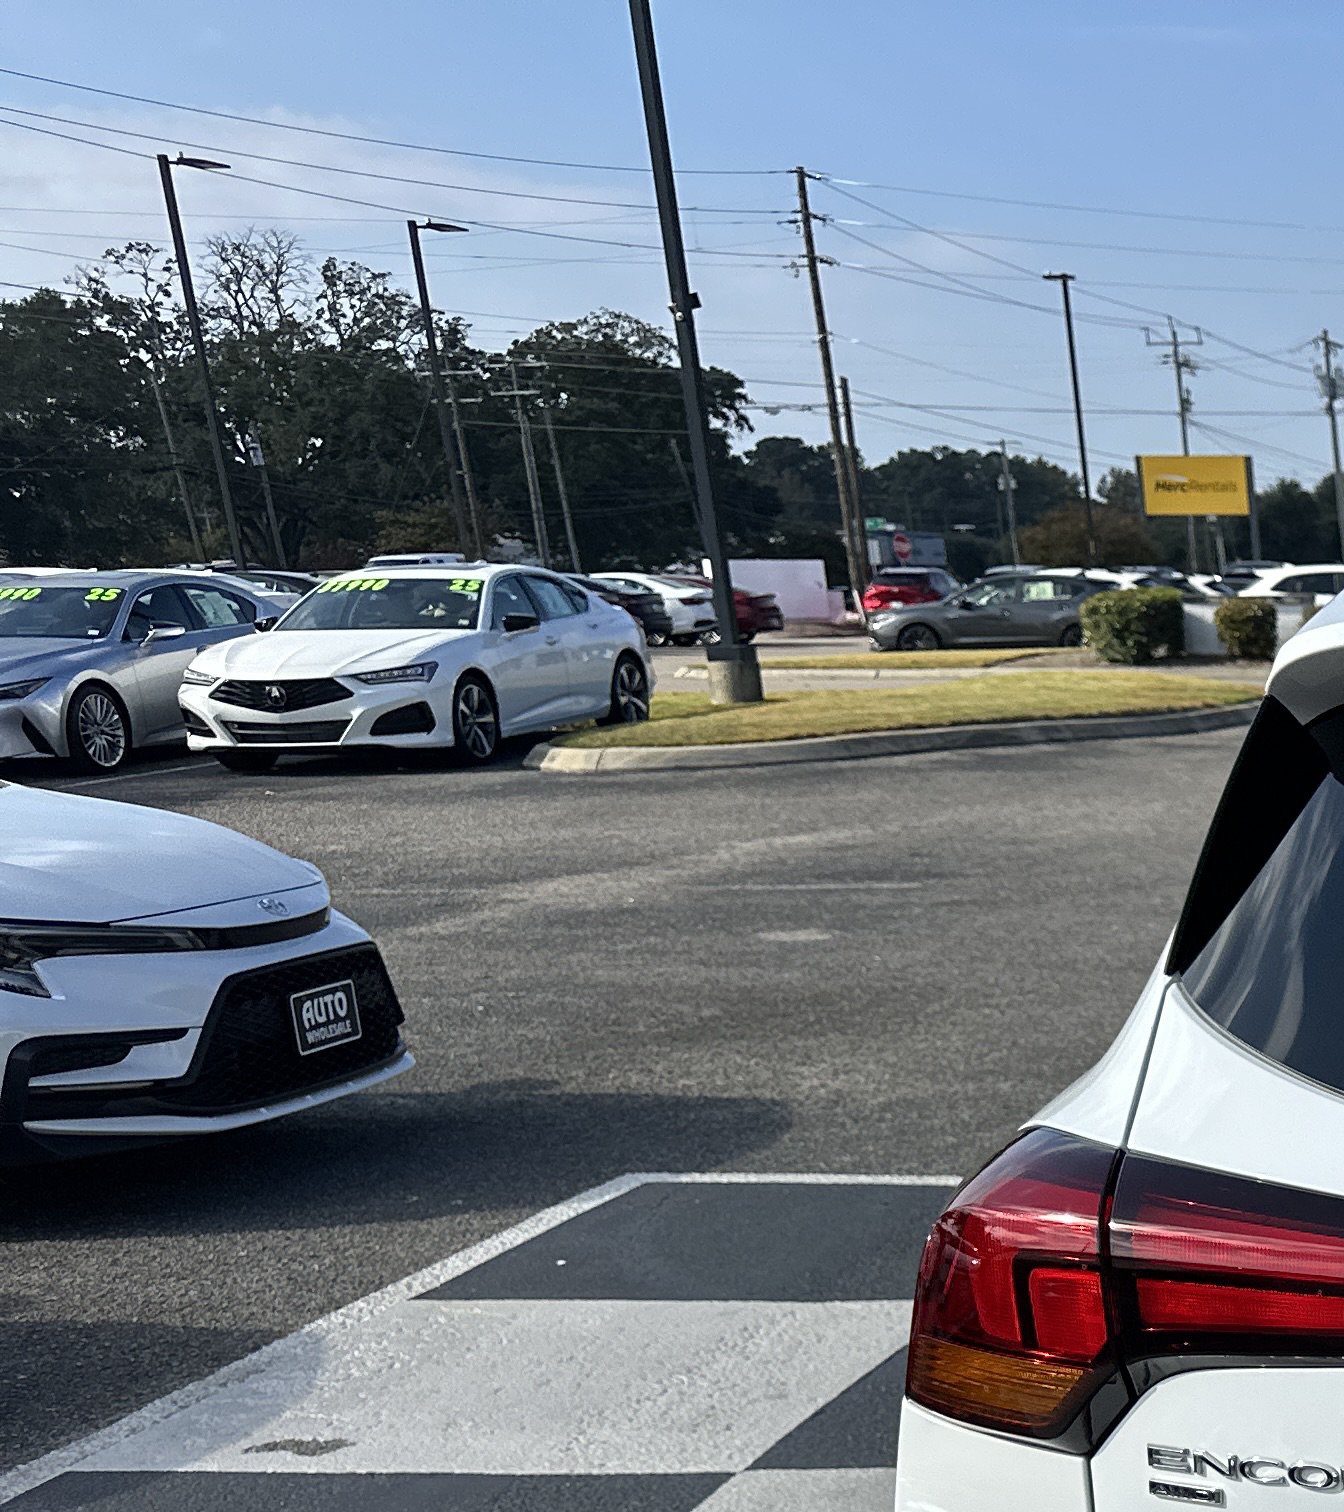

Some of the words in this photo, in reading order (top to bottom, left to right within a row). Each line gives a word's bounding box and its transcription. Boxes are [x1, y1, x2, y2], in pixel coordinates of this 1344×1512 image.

[0, 588, 41, 601] 990
[84, 588, 121, 601] 25
[449, 579, 481, 591] 25
[302, 991, 348, 1030] AUTO
[305, 1019, 352, 1044] WHOLESALE
